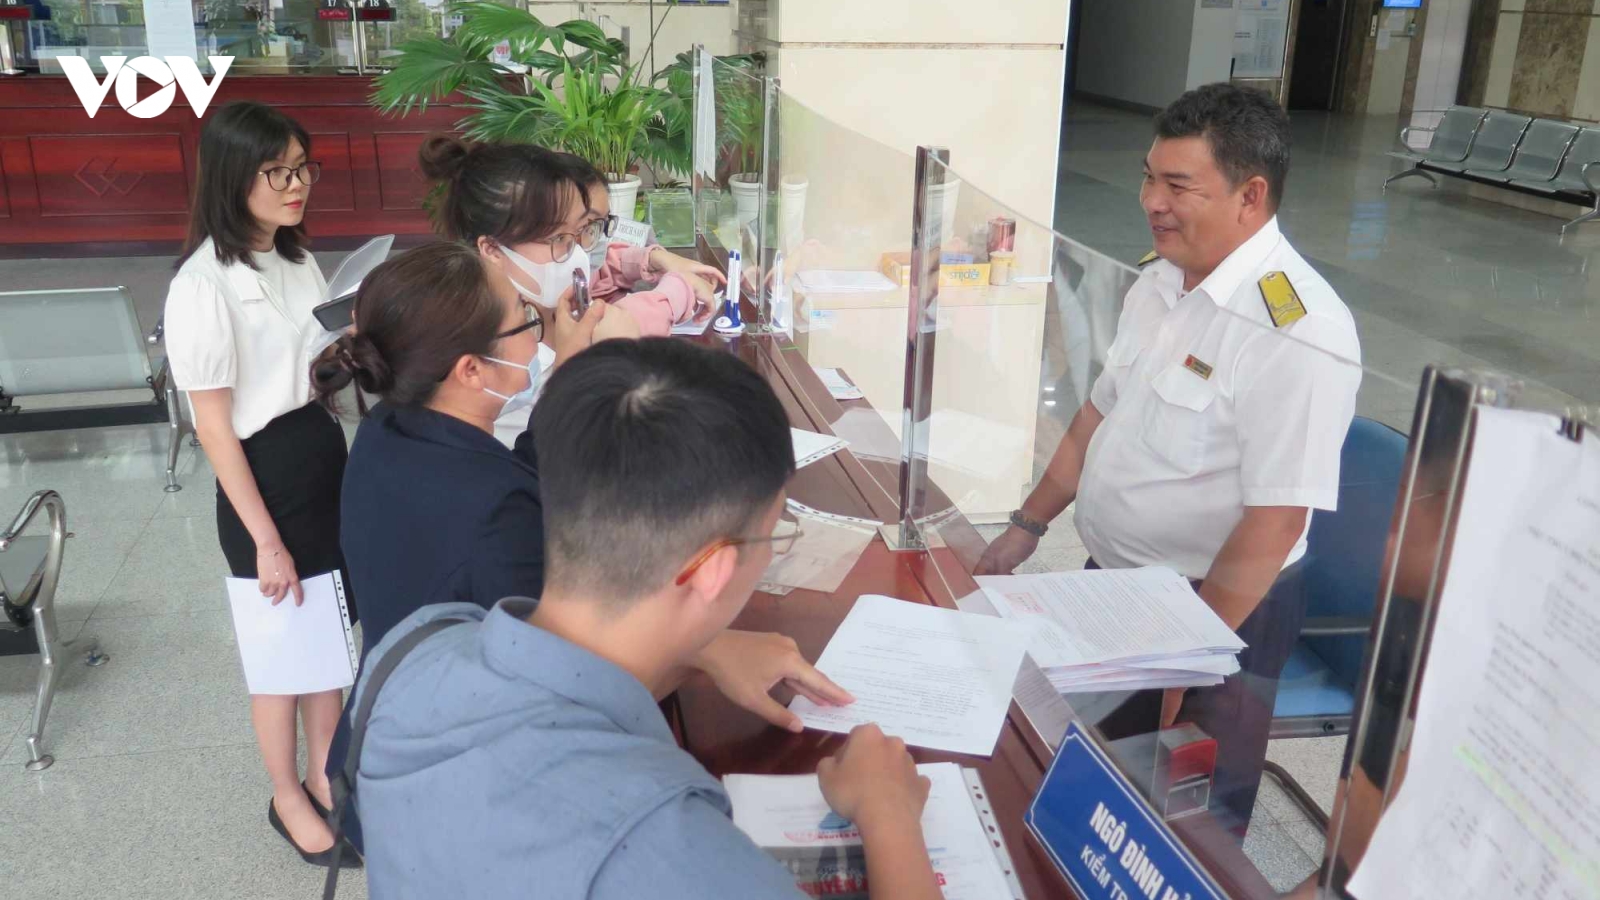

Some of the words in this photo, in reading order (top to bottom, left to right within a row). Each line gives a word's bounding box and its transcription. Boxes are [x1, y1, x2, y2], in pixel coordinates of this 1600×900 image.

[1080, 844, 1112, 889] KIỂM
[1089, 800, 1128, 854] NGÔ
[1119, 838, 1165, 900] ĐÌNH
